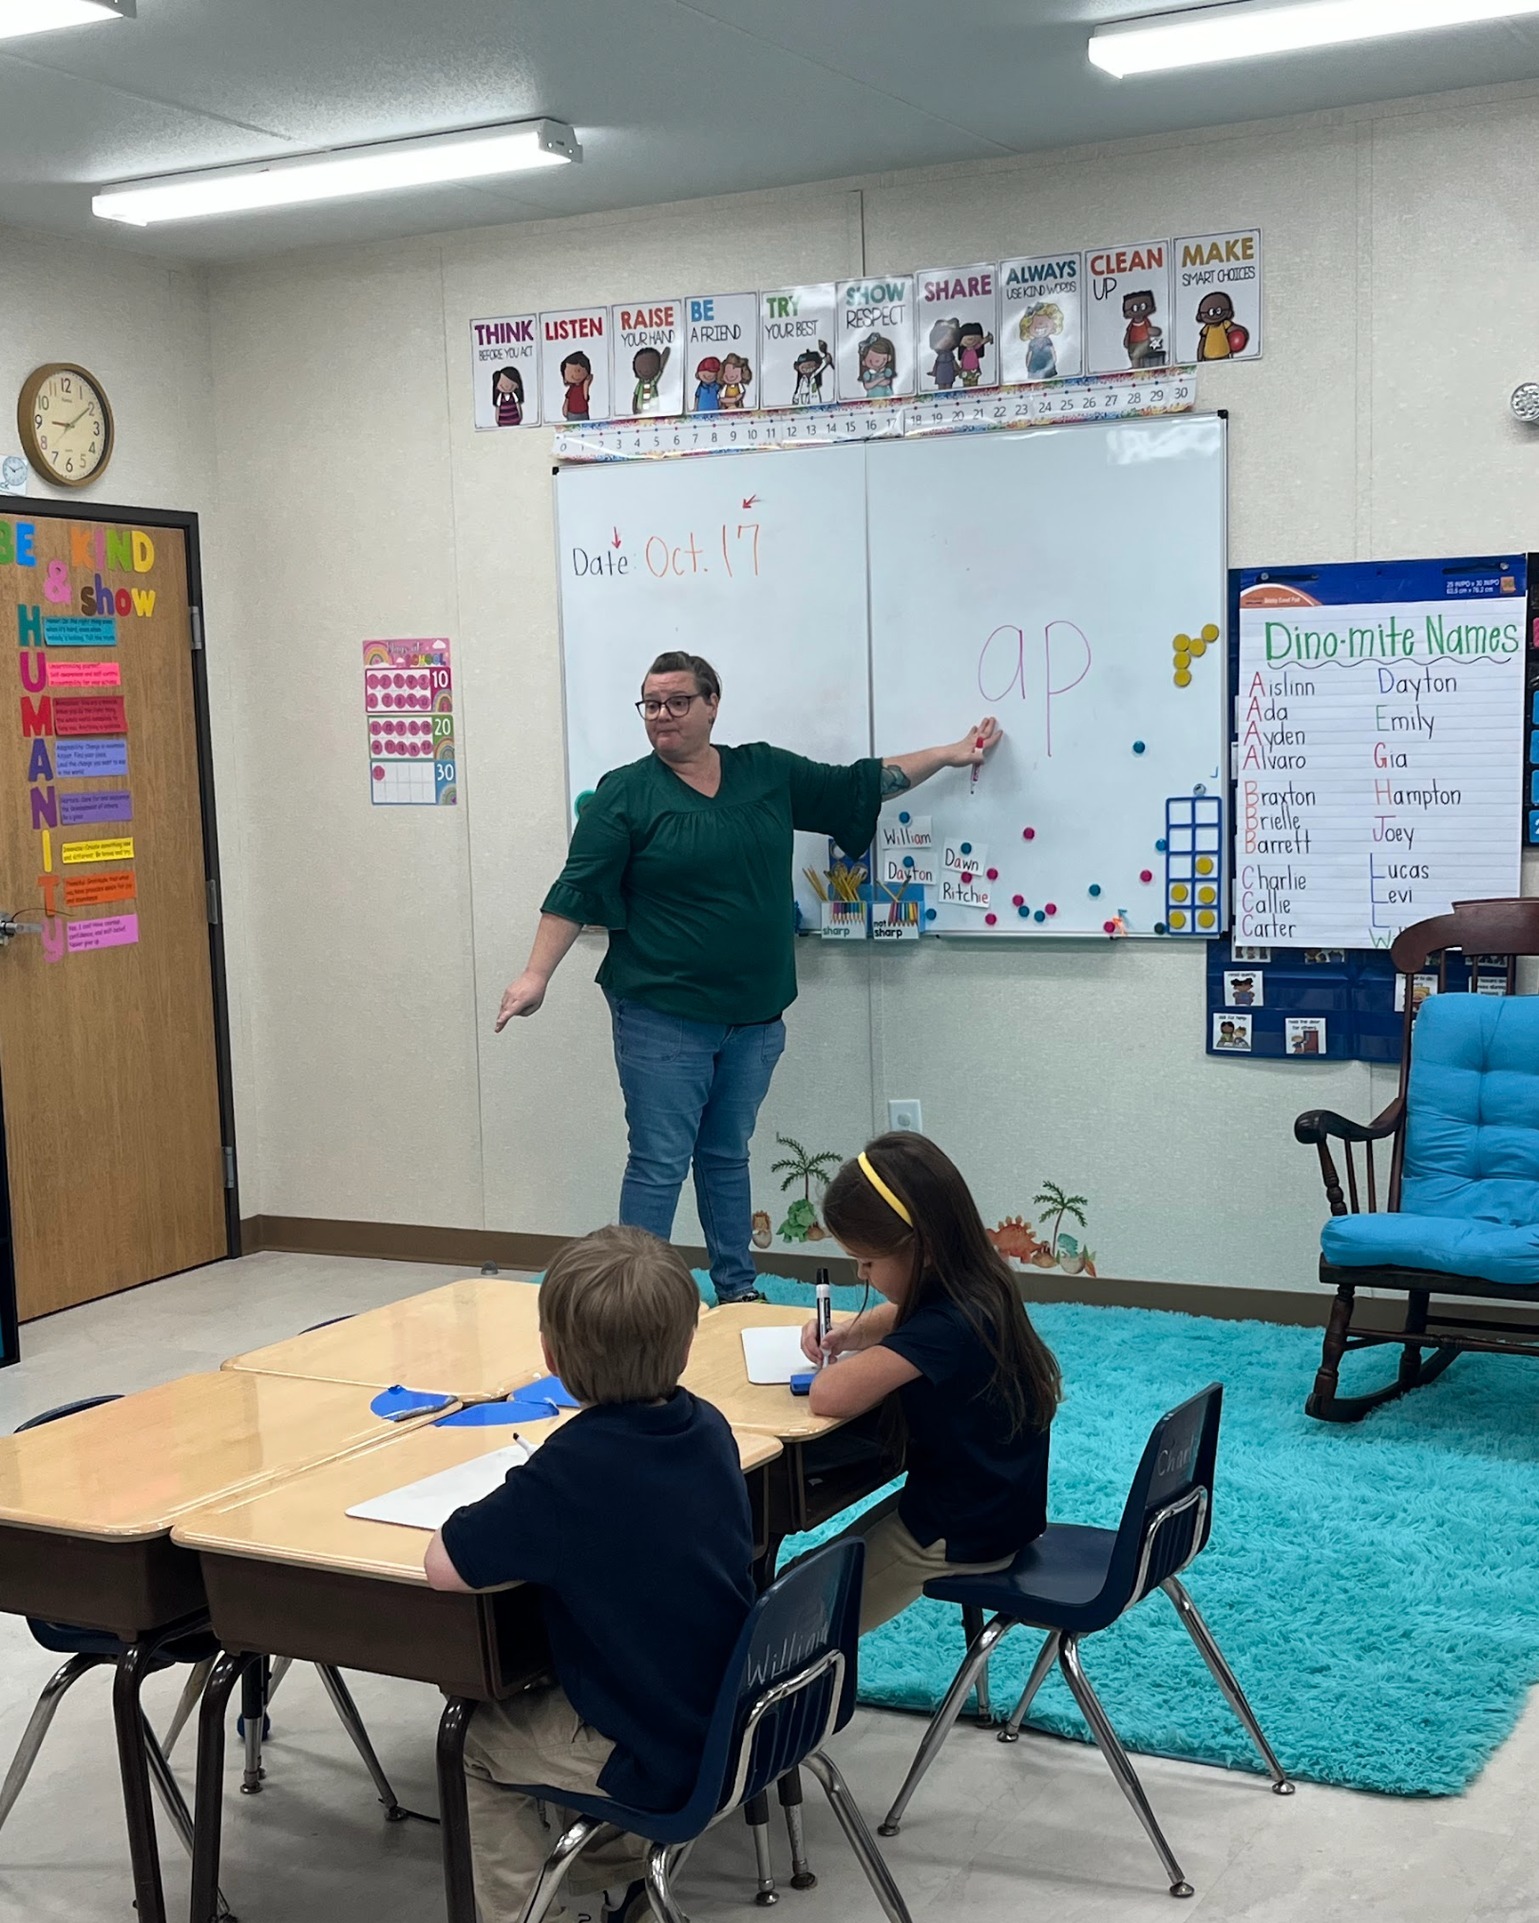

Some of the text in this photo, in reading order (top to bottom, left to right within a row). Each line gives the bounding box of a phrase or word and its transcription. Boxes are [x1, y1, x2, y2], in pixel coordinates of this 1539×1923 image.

[1090, 247, 1163, 277] CLEAN
[1181, 237, 1254, 268] MAKE
[1006, 260, 1077, 285] ALWAYS
[1181, 265, 1256, 287] SMART CHOICES
[846, 281, 905, 306] SHOW
[924, 274, 992, 302] SHARE
[1093, 277, 1117, 301] UP
[620, 306, 674, 331] RAISE
[690, 300, 714, 323] BE
[766, 295, 801, 320] TRY
[846, 304, 906, 330] RESPECT
[474, 320, 534, 346] THINK
[545, 317, 603, 341] LISTEN
[621, 329, 676, 348] YOUR HAND
[690, 325, 742, 343] A FRIEND
[765, 320, 819, 340] YOUR BEST
[478, 348, 503, 361] BEFORE
[504, 347, 519, 359] YOU
[61, 378, 71, 393] 12
[38, 395, 49, 410] 10
[88, 401, 95, 416] 2
[35, 414, 43, 430] 9
[93, 421, 100, 436] 3
[616, 440, 622, 449] 3
[634, 439, 640, 448] 4
[653, 437, 659, 447] 5
[673, 435, 680, 445] 6
[692, 434, 698, 444] 7
[711, 433, 717, 443] 8
[730, 431, 736, 441] 9
[747, 430, 757, 440] 10
[766, 428, 775, 439] 11
[787, 426, 797, 437] 12
[806, 425, 817, 435] 13
[826, 423, 836, 433] 14
[845, 422, 855, 432] 15
[866, 420, 876, 431] 16
[911, 416, 921, 426] 18
[932, 413, 942, 424] 19
[952, 411, 963, 422] 20
[973, 409, 984, 420] 21
[994, 406, 1006, 417] 22
[1016, 405, 1028, 416] 23
[1039, 402, 1052, 414] 24
[1060, 400, 1073, 411] 25
[1083, 398, 1096, 409] 26
[1105, 395, 1117, 407] 27
[1128, 393, 1141, 405] 28
[1150, 390, 1163, 402] 29
[1174, 386, 1188, 399] 30
[41, 435, 48, 450] 8
[88, 441, 96, 454] 4
[51, 451, 59, 464] 7
[66, 457, 73, 472] 6
[79, 453, 86, 468] 5
[71, 527, 155, 573] KIND
[645, 532, 708, 578] Oct.
[722, 524, 760, 578] 17
[44, 559, 72, 604] &
[81, 573, 156, 618] show
[1426, 614, 1519, 655] Names
[432, 670, 449, 688] 10
[978, 620, 1091, 757] ap
[1248, 671, 1315, 697] Aislinn
[1378, 667, 1457, 701] Dayton
[1246, 696, 1288, 722] Ada
[434, 718, 451, 736] 20
[1376, 704, 1435, 740] Emily
[1243, 720, 1306, 752] Ayden
[1242, 745, 1306, 771] Alvaro
[1373, 742, 1408, 769] Gia
[437, 764, 454, 781] 30
[1244, 780, 1316, 807] Braxton
[1375, 778, 1461, 810] Hampton
[1246, 802, 1301, 831] Brielle
[883, 827, 932, 846] William
[1245, 829, 1312, 854] Barrett
[1372, 815, 1414, 850] Joey
[888, 861, 933, 884] Dayton
[945, 848, 979, 872] Dawn
[1369, 852, 1429, 879] Lucas
[1242, 864, 1307, 891] Charlie
[943, 881, 989, 904] Ritchie
[1242, 889, 1291, 914] Callie
[1371, 878, 1413, 904] Levi
[823, 926, 850, 937] sharp
[873, 920, 887, 928] not
[874, 927, 903, 939] sharp
[1242, 914, 1297, 938] Carter
